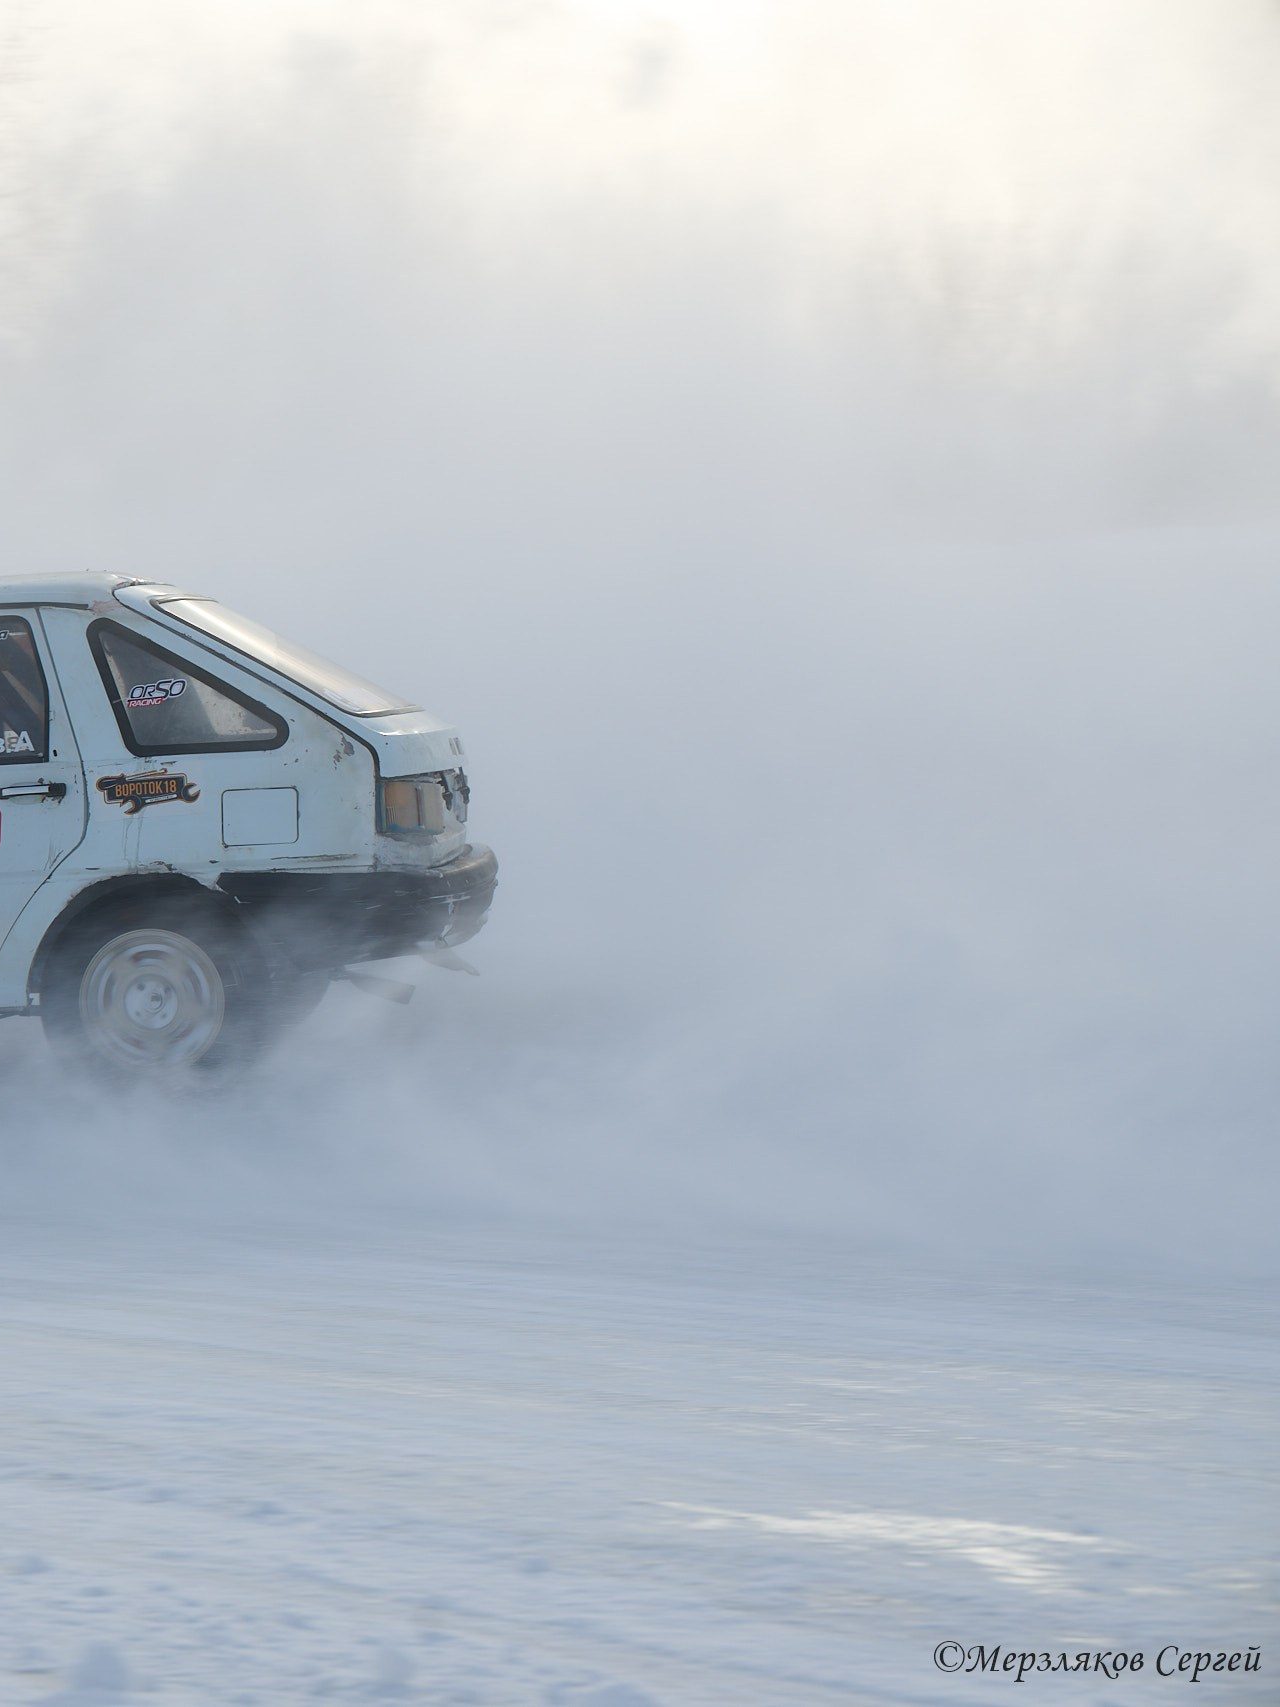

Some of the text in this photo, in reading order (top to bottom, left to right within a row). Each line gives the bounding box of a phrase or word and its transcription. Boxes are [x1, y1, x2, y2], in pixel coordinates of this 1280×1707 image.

[128, 698, 162, 708] RACING
[115, 780, 177, 797] ВОРОТОК 18
